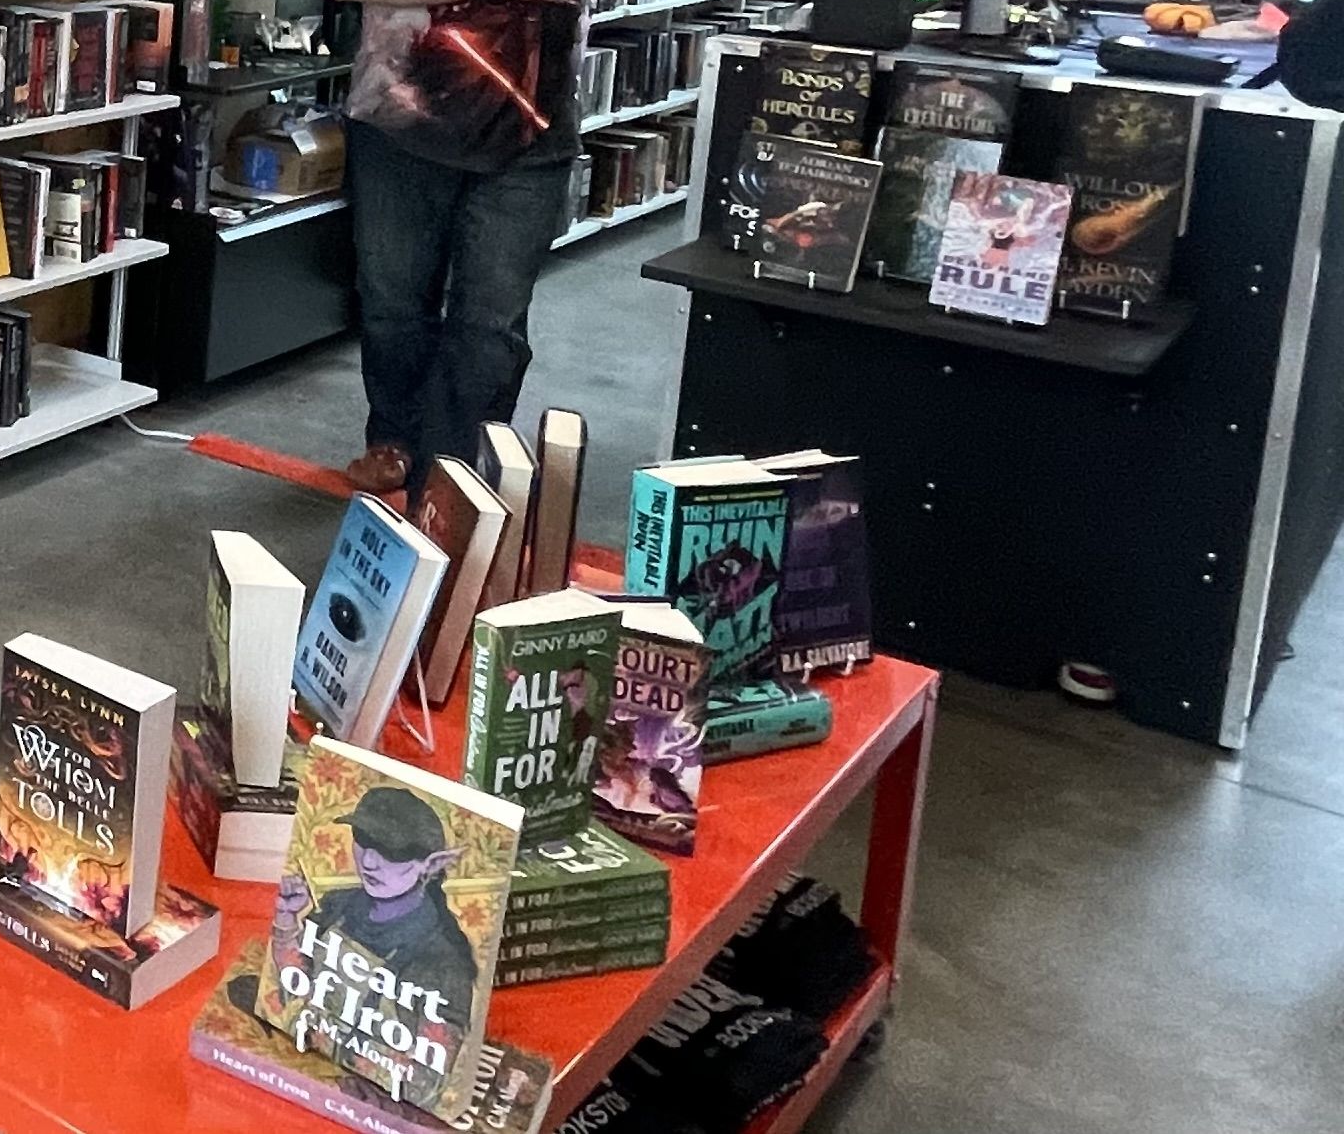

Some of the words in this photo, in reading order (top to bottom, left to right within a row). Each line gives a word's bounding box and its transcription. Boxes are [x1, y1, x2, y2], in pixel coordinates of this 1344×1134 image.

[781, 68, 844, 91] BONDS
[799, 90, 823, 102] OF
[762, 99, 857, 124] HERCULES
[940, 90, 966, 108] THE
[939, 264, 1048, 300] RULE
[634, 509, 650, 552] RUIN
[681, 504, 713, 523] THIS
[360, 526, 388, 561] HOLE
[678, 517, 786, 586] RUIN
[351, 547, 372, 579] THE
[370, 568, 392, 598] SKY
[315, 631, 348, 678] DANIEL
[474, 647, 489, 670] ALL
[511, 636, 564, 657] GINNY
[567, 628, 608, 650] BAIRD
[474, 674, 488, 690] IN
[620, 647, 696, 683] OURT
[311, 657, 348, 709] WILSON
[505, 669, 563, 713] ALL
[614, 677, 685, 712] DEAD
[81, 697, 124, 728] LYNN
[472, 691, 487, 717] FOR
[528, 709, 561, 750] IN
[12, 723, 116, 809] WHOM
[64, 748, 91, 769] FOR
[494, 748, 557, 794] FOR
[35, 773, 60, 793] THE
[68, 790, 110, 821] BELLE
[12, 777, 115, 856] TOLLS
[528, 893, 550, 907] FOR
[6, 916, 50, 952] TOLLS
[530, 917, 553, 932] FOR
[526, 942, 548, 956] FOR
[298, 919, 449, 1024] Heart
[520, 967, 543, 982] FOR
[280, 966, 343, 1010] of
[339, 986, 448, 1076] Iron
[213, 1048, 256, 1079] Heart
[258, 1071, 275, 1089] of
[274, 1074, 310, 1101] Iron
[324, 1098, 360, 1122] C.M.
[362, 1115, 402, 1134] Alon
